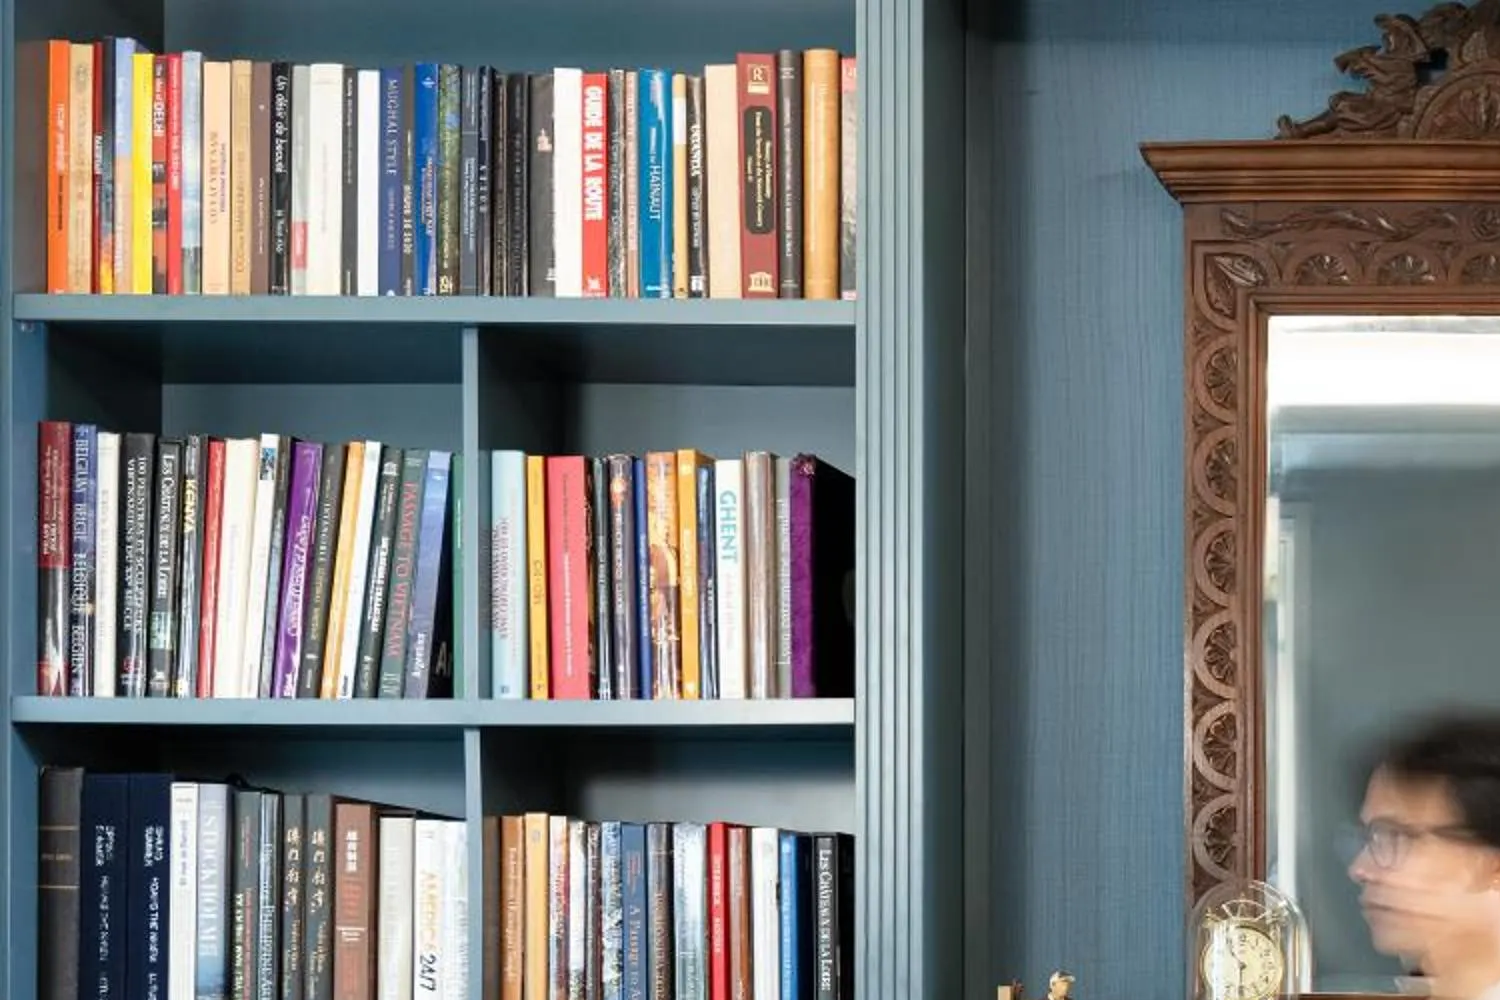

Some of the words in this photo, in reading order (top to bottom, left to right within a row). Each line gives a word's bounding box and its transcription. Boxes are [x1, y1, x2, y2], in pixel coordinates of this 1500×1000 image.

[585, 86, 602, 128] GUIDE
[585, 132, 602, 150] DE
[585, 153, 602, 173] LA
[585, 176, 602, 221] ROUTE
[649, 165, 661, 221] HAINAUT
[719, 490, 738, 564] GHENT
[418, 954, 438, 992] 24/7
